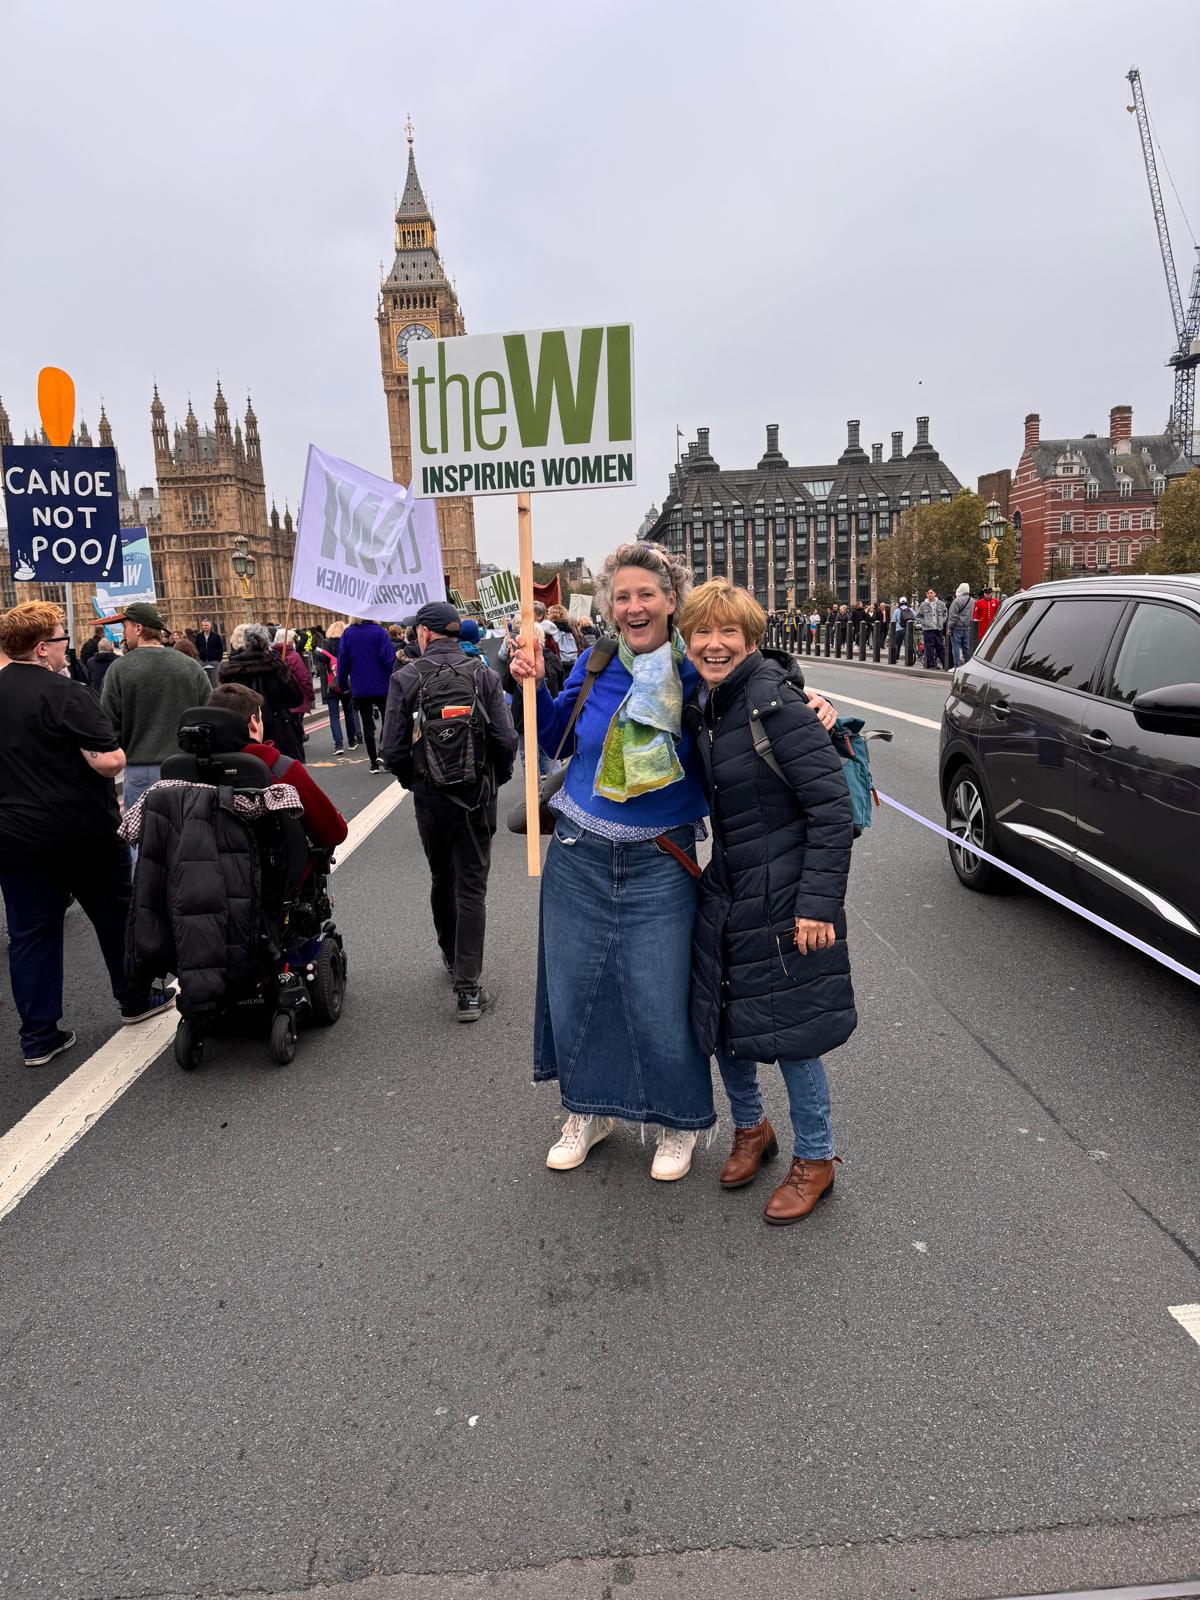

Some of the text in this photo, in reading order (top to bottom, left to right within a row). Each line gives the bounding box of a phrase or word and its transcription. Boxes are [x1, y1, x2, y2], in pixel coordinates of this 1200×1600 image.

[412, 325, 632, 455] theWI
[5, 466, 113, 497] CANOE
[422, 453, 633, 494] INSPIRING WOMEN
[32, 506, 97, 529] NOT
[32, 534, 117, 577] POO!
[479, 570, 518, 609] theWI
[486, 603, 520, 619] INSPIRING WOMEN
